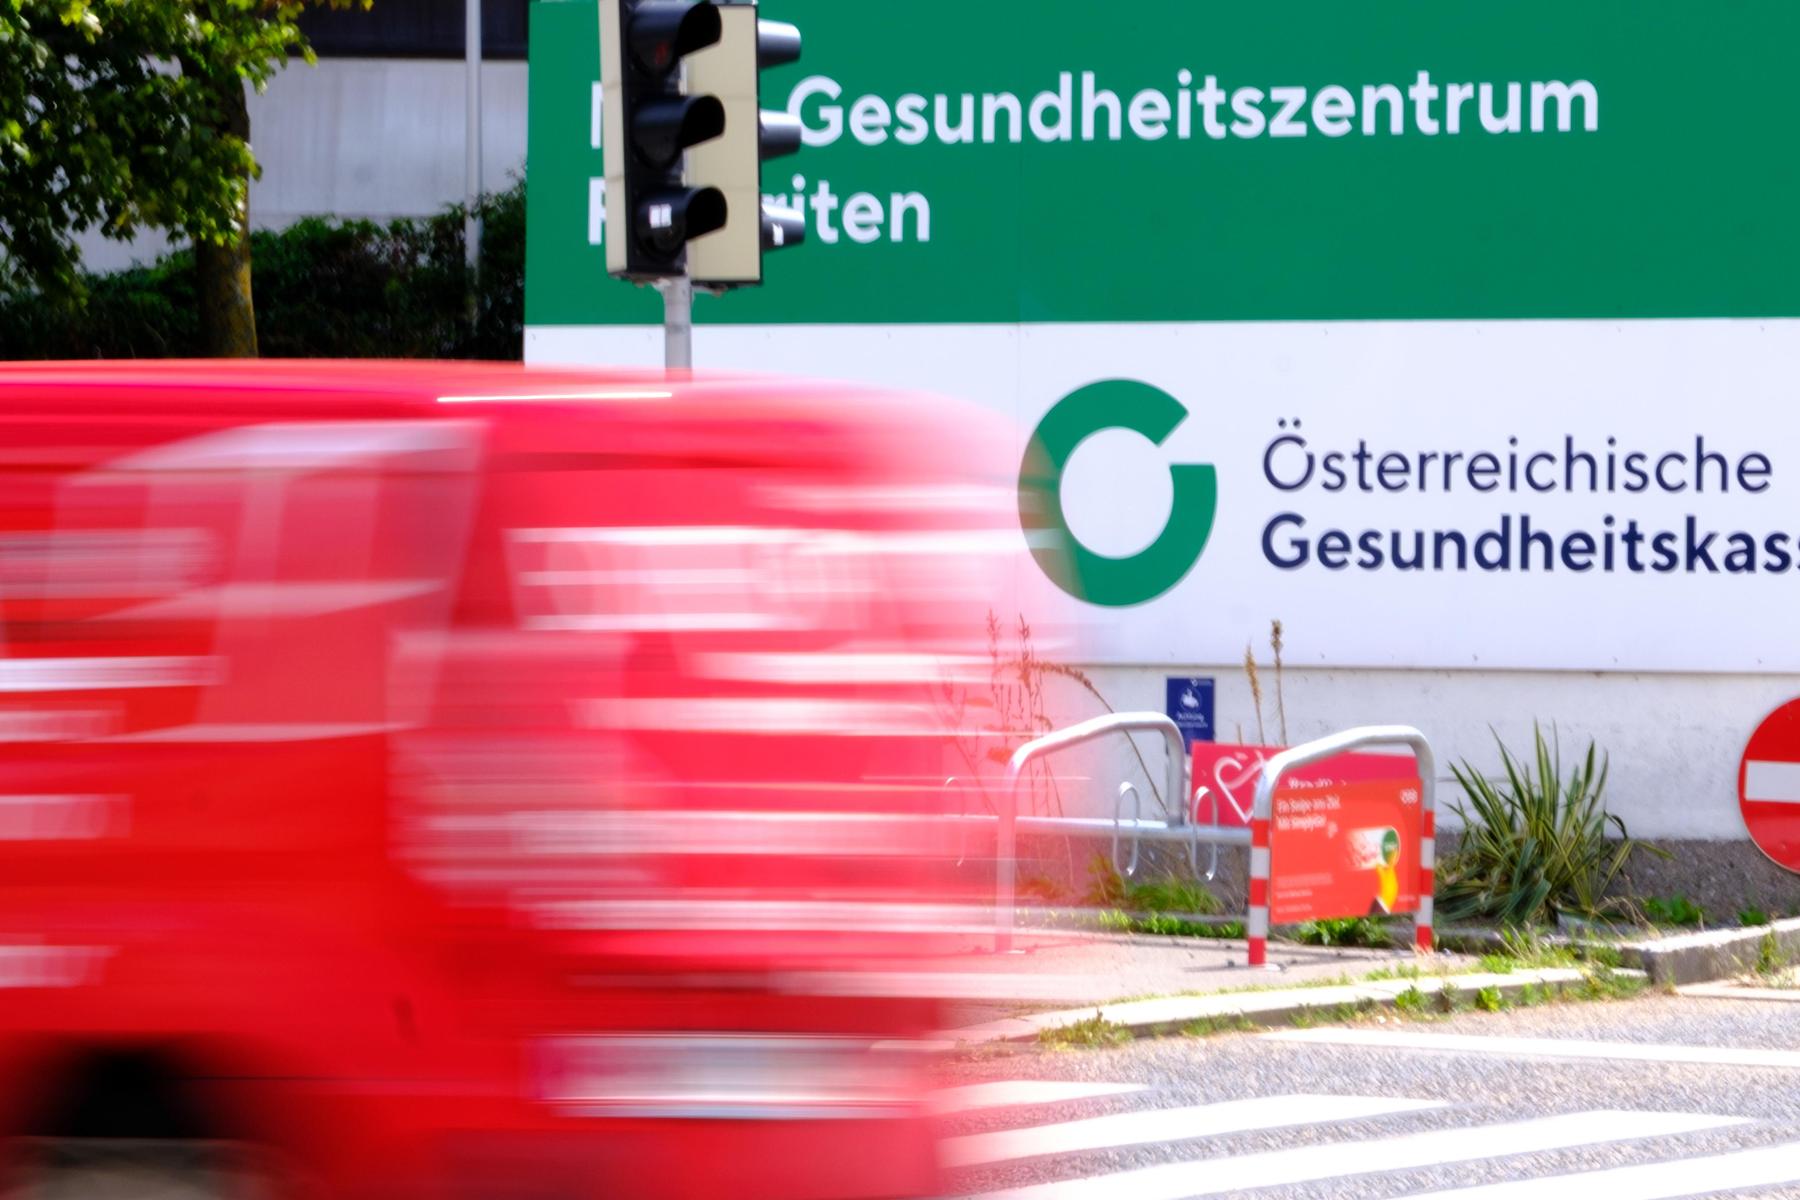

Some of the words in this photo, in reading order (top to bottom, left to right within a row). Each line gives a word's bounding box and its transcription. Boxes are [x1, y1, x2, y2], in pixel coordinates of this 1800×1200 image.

[787, 69, 1599, 147] Gesundheitszentrum
[1262, 417, 1772, 493] Österreichische
[1261, 511, 1800, 574] Gesundheitskas
